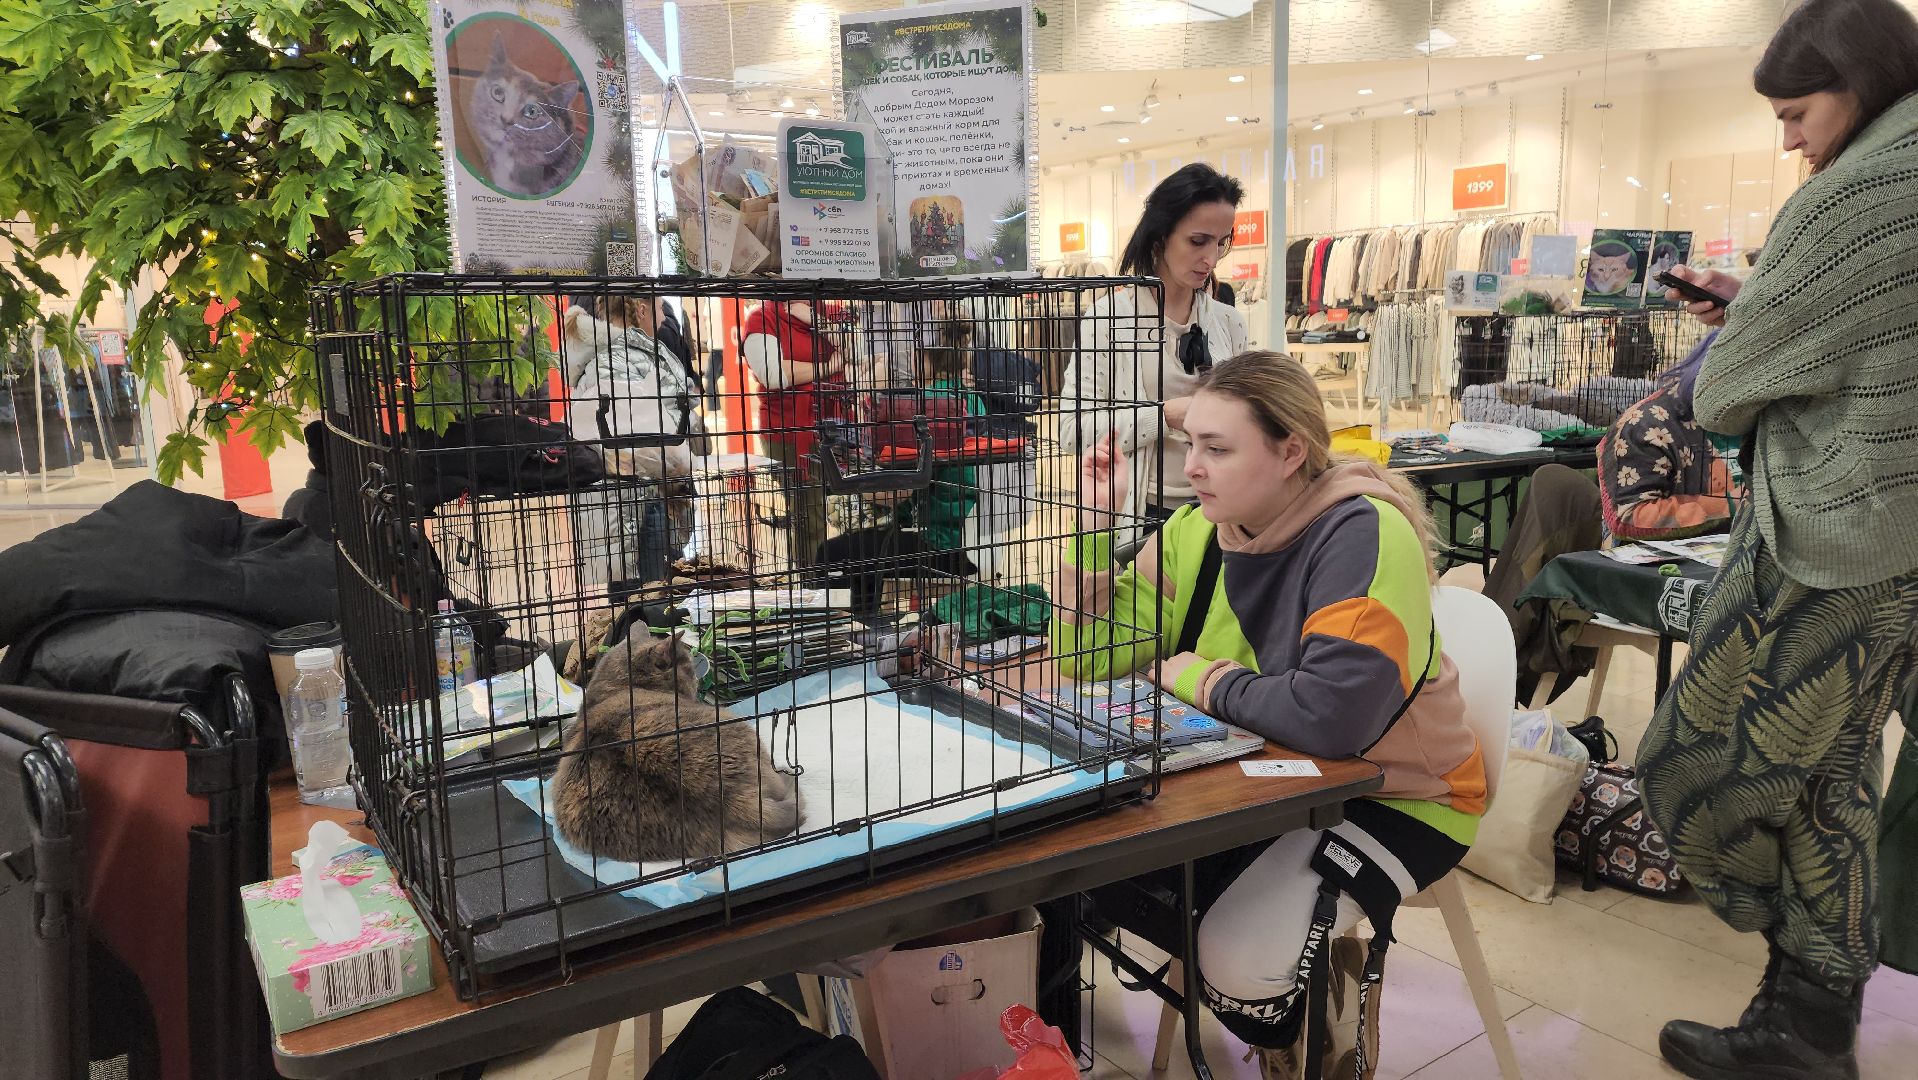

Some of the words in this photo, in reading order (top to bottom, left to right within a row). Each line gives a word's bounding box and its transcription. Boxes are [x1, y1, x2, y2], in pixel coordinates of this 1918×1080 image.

[883, 76, 889, 84] И
[890, 74, 922, 84] СОБАК,
[923, 70, 966, 82] КОТОРЫЕ
[967, 67, 994, 79] ИЩУТ
[911, 87, 954, 97] Сегодня,
[873, 102, 912, 113] добрым
[914, 100, 947, 110] Дедом
[948, 96, 994, 106] Морозом
[883, 114, 913, 123] может
[916, 112, 941, 120] стать
[943, 106, 985, 119] каждый!
[908, 121, 952, 133] влажный
[955, 121, 980, 131] корм
[981, 118, 1000, 127] для
[949, 131, 994, 142] пелёнки,
[907, 148, 923, 156] это
[926, 147, 937, 156] то,
[939, 145, 961, 154] чего
[963, 142, 996, 152] всегда
[998, 141, 1011, 149] не
[904, 158, 958, 168] животным,
[960, 155, 983, 164] пока
[984, 154, 1004, 162] они
[796, 166, 840, 178] УЮТНЫЙ
[841, 169, 863, 180] ДОМ
[901, 171, 942, 182] приютах
[953, 165, 1010, 177] временных
[919, 180, 951, 192] домах!
[471, 195, 507, 204] ИСТОРИЯ
[795, 249, 834, 257] ОГРОМНОЕ
[834, 250, 867, 259] СПАСИБО
[790, 257, 800, 265] ЗА
[801, 258, 833, 266] ПОМОЩЬ
[833, 259, 875, 268] ЖИВОТНЫМ
